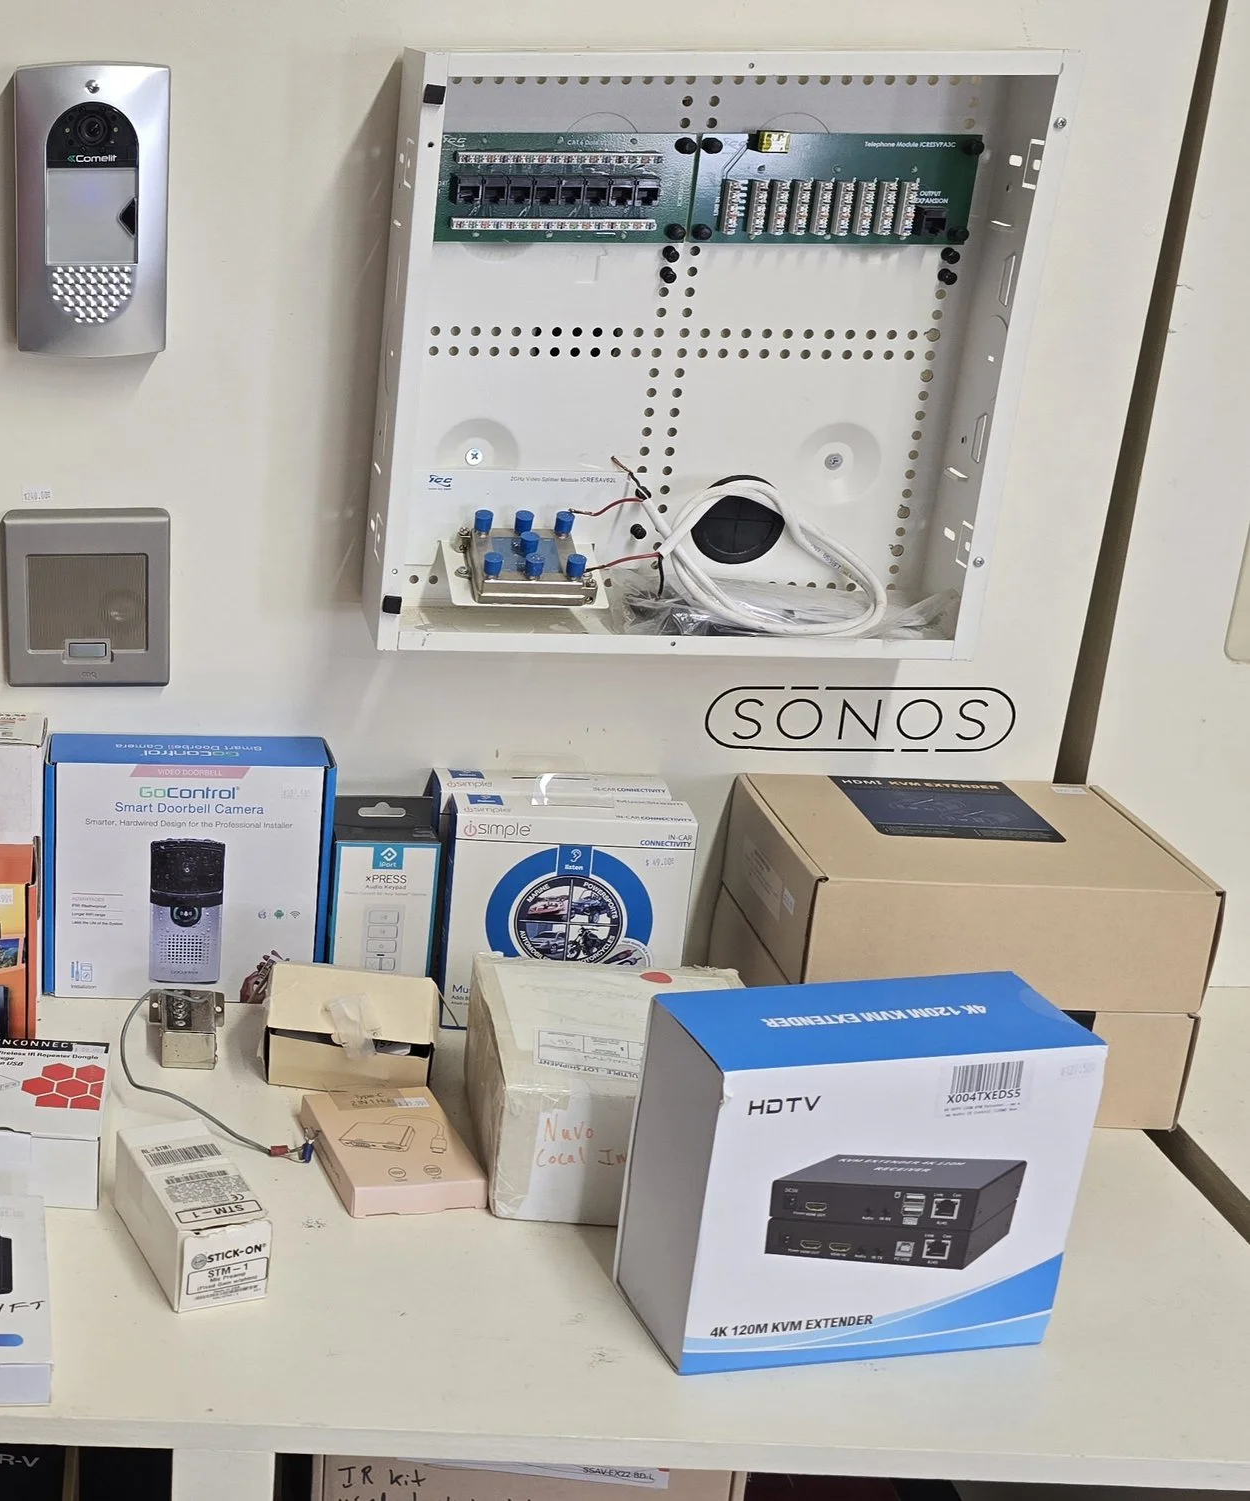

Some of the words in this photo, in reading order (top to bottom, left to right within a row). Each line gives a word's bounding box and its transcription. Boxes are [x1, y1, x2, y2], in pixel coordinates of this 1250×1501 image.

[76, 154, 117, 163] Comelit
[732, 698, 989, 741] SONOS
[142, 750, 240, 758] GoControl
[158, 768, 181, 776] VIDEO
[140, 787, 236, 799] GoControl
[924, 782, 1000, 790] EXTENDER
[115, 802, 153, 813] Smart
[158, 802, 210, 814] Doorbell
[215, 804, 264, 814] Camera
[85, 818, 117, 827] Smarter,
[120, 819, 158, 827] Hardwired
[160, 820, 186, 828] Design
[640, 840, 692, 848] CONNECTIVITY
[527, 884, 550, 903] MARINE
[583, 882, 618, 919] POWERSPORTS
[857, 1008, 906, 1023] KVM
[903, 1006, 961, 1019] 120M
[958, 1004, 987, 1015] 4K
[761, 1013, 862, 1028] EXTENDER
[947, 1088, 1021, 1104] X004TXEDS5
[747, 1096, 821, 1115] HDTV
[544, 1114, 594, 1142] Nuvo
[207, 1243, 263, 1263] STICK-ON
[710, 1326, 728, 1337] 4K
[732, 1323, 768, 1336] 120M
[771, 1320, 802, 1333] KVM
[805, 1314, 873, 1330] EXTENDER
[337, 1466, 373, 1488] IR
[389, 1467, 426, 1487] kit
